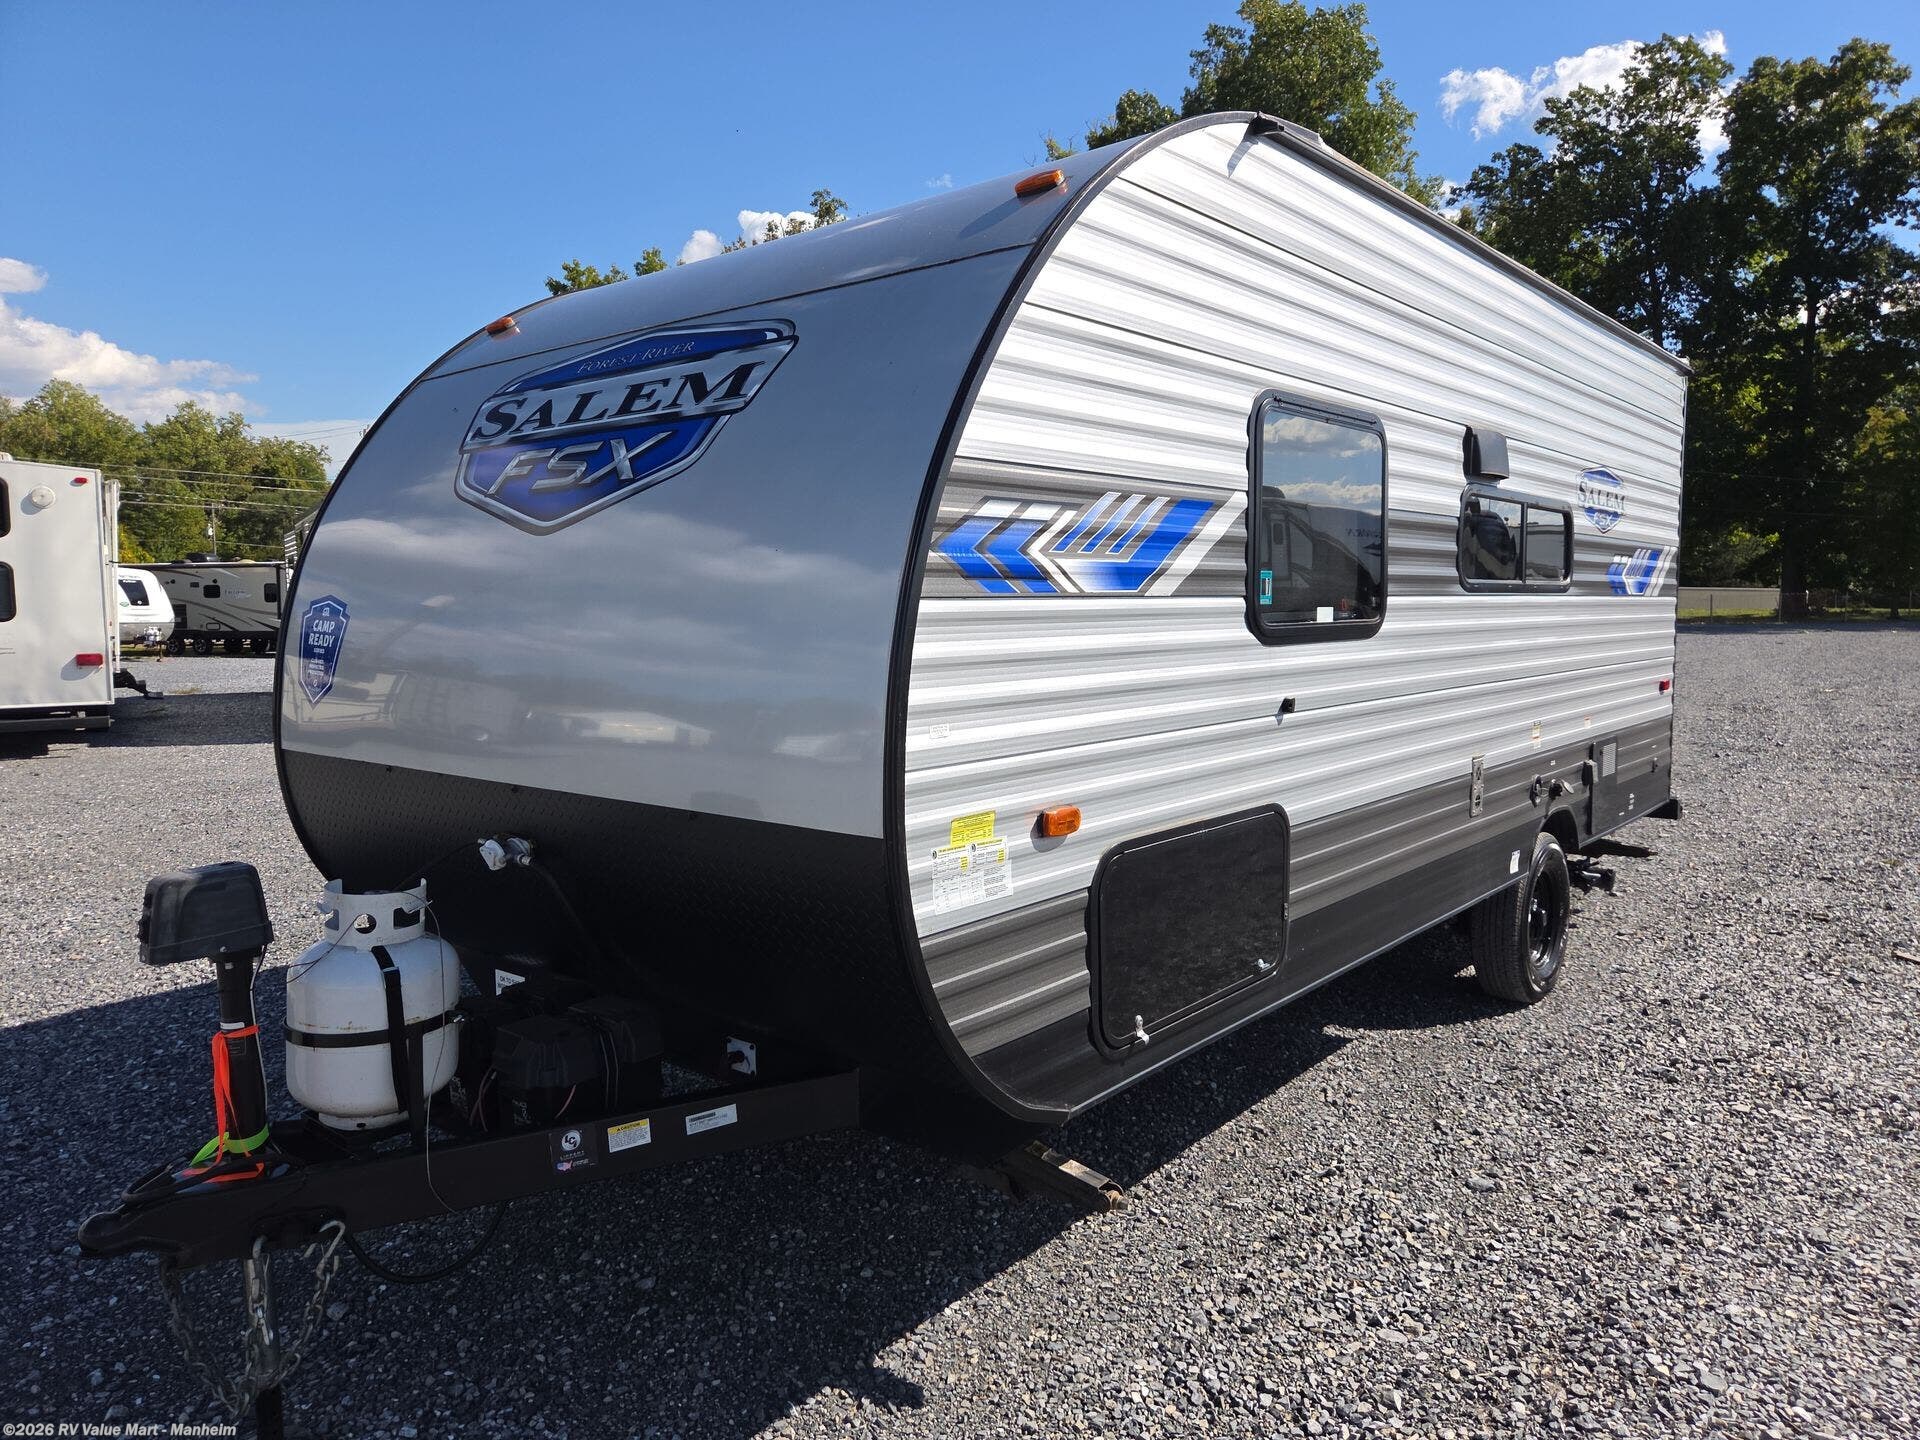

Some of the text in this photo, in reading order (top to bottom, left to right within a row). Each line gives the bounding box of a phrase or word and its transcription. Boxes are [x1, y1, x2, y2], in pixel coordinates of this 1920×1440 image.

[577, 340, 696, 374] FOREST RIVER
[472, 360, 766, 441] SALEM
[486, 430, 674, 495] FSX
[1578, 480, 1625, 512] SALEM
[308, 633, 335, 648] READY
[312, 619, 335, 633] CAMP
